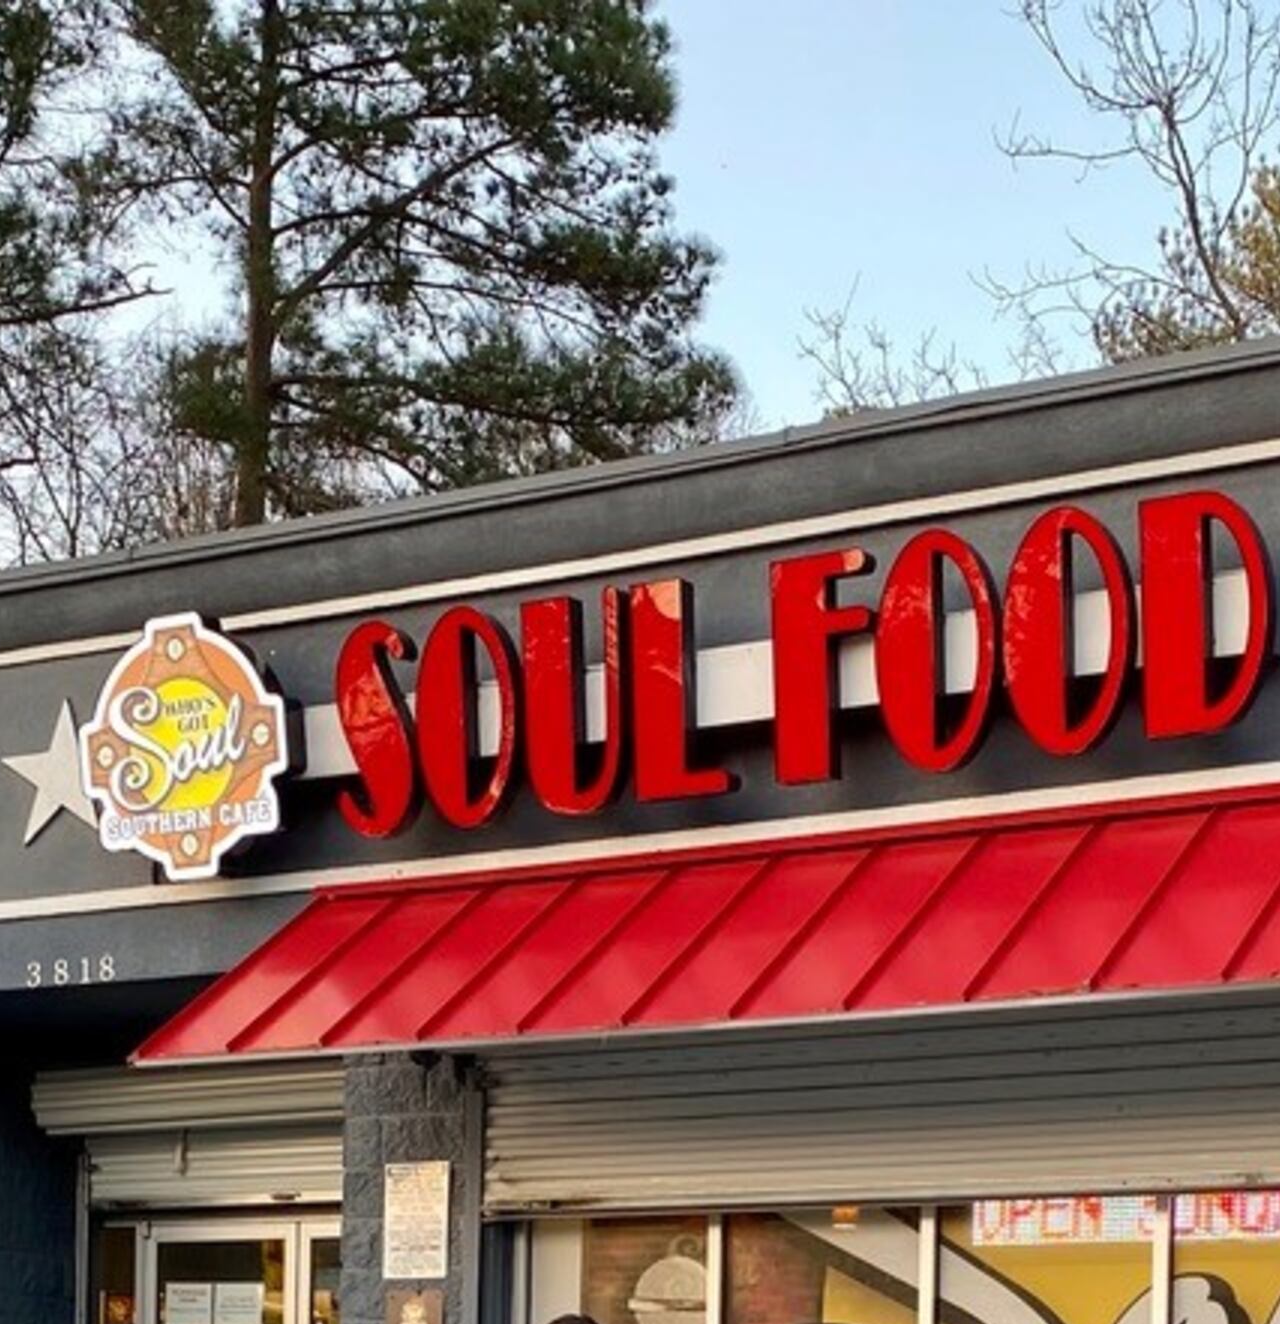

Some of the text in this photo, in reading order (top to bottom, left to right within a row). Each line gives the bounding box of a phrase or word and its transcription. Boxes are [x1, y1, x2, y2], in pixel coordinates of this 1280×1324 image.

[334, 490, 1272, 841] SOUL FOOD
[108, 686, 246, 811] Soul
[177, 714, 209, 732] GOT
[106, 806, 212, 841] SOUTHERN
